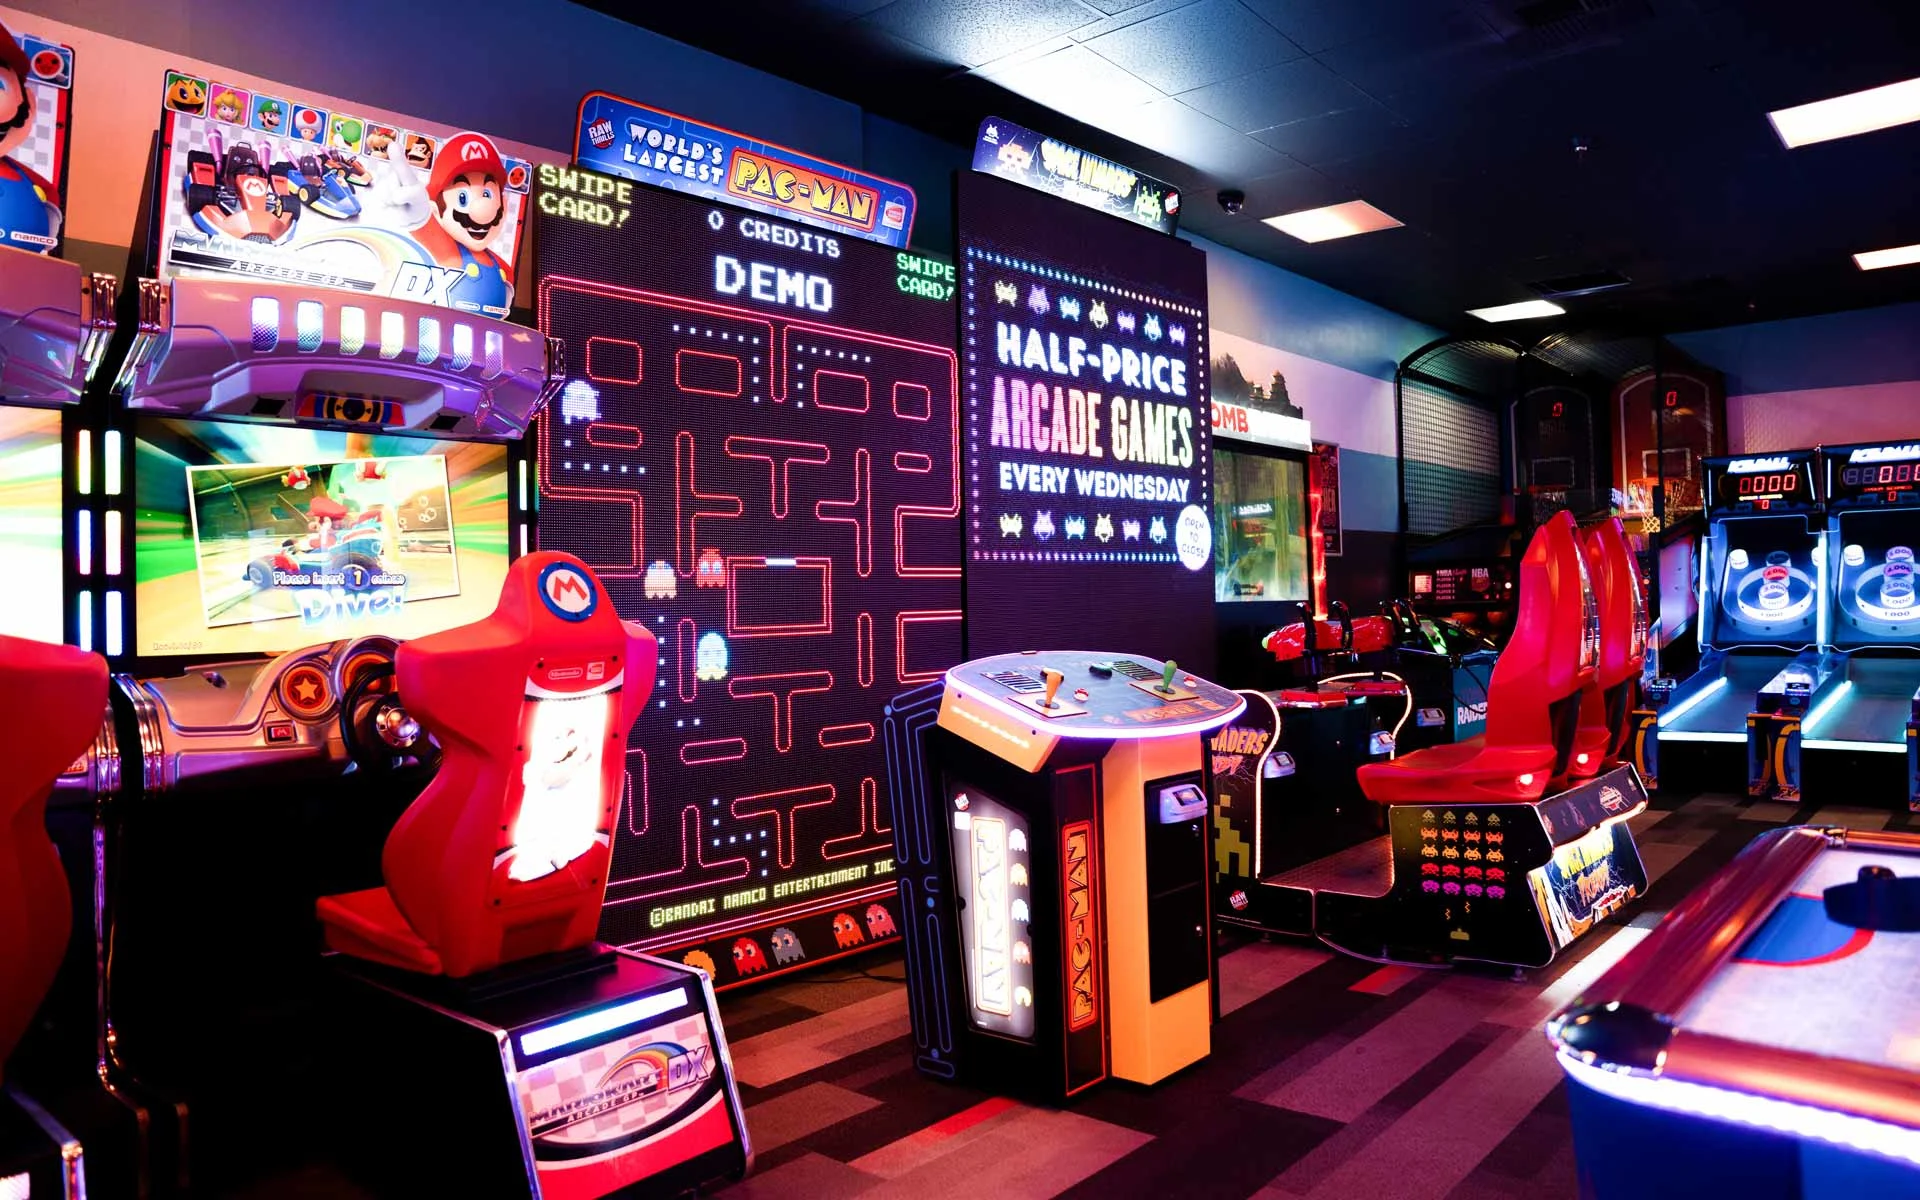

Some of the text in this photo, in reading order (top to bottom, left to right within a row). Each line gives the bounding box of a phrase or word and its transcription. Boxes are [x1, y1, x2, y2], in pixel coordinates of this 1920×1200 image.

[588, 120, 613, 139] RAW
[591, 131, 615, 145] THRILLS
[629, 123, 723, 165] WORLD'S
[539, 163, 632, 204] SWIPE
[623, 143, 724, 185] LARGEST
[539, 192, 630, 228] CARD!
[734, 157, 872, 225] PAC-MAN
[13, 232, 55, 245] namco
[708, 210, 841, 258] 0 CREDITS
[389, 261, 466, 308] DX
[714, 254, 834, 313] DEMO
[896, 252, 956, 282] SWIPE
[896, 274, 954, 302] CARD!
[997, 321, 1187, 397] HALF-PRICE
[990, 375, 1193, 469] ARCADE GAMES
[1211, 402, 1249, 434] OMB
[999, 461, 1190, 503] EVERY WEDNESDAY
[272, 571, 311, 586] Please
[312, 571, 345, 585] insert
[353, 569, 362, 585] 1
[1471, 567, 1489, 578] NBA
[297, 587, 404, 627] Dive!
[1211, 727, 1269, 755] VADERS
[723, 887, 767, 910] NAMCO
[773, 864, 869, 898] ENTERTAINMENT
[873, 859, 897, 876] INC.
[1068, 831, 1093, 1022] PAC-MAN
[667, 1045, 711, 1092] DX
[567, 1100, 618, 1122] ARCADE
